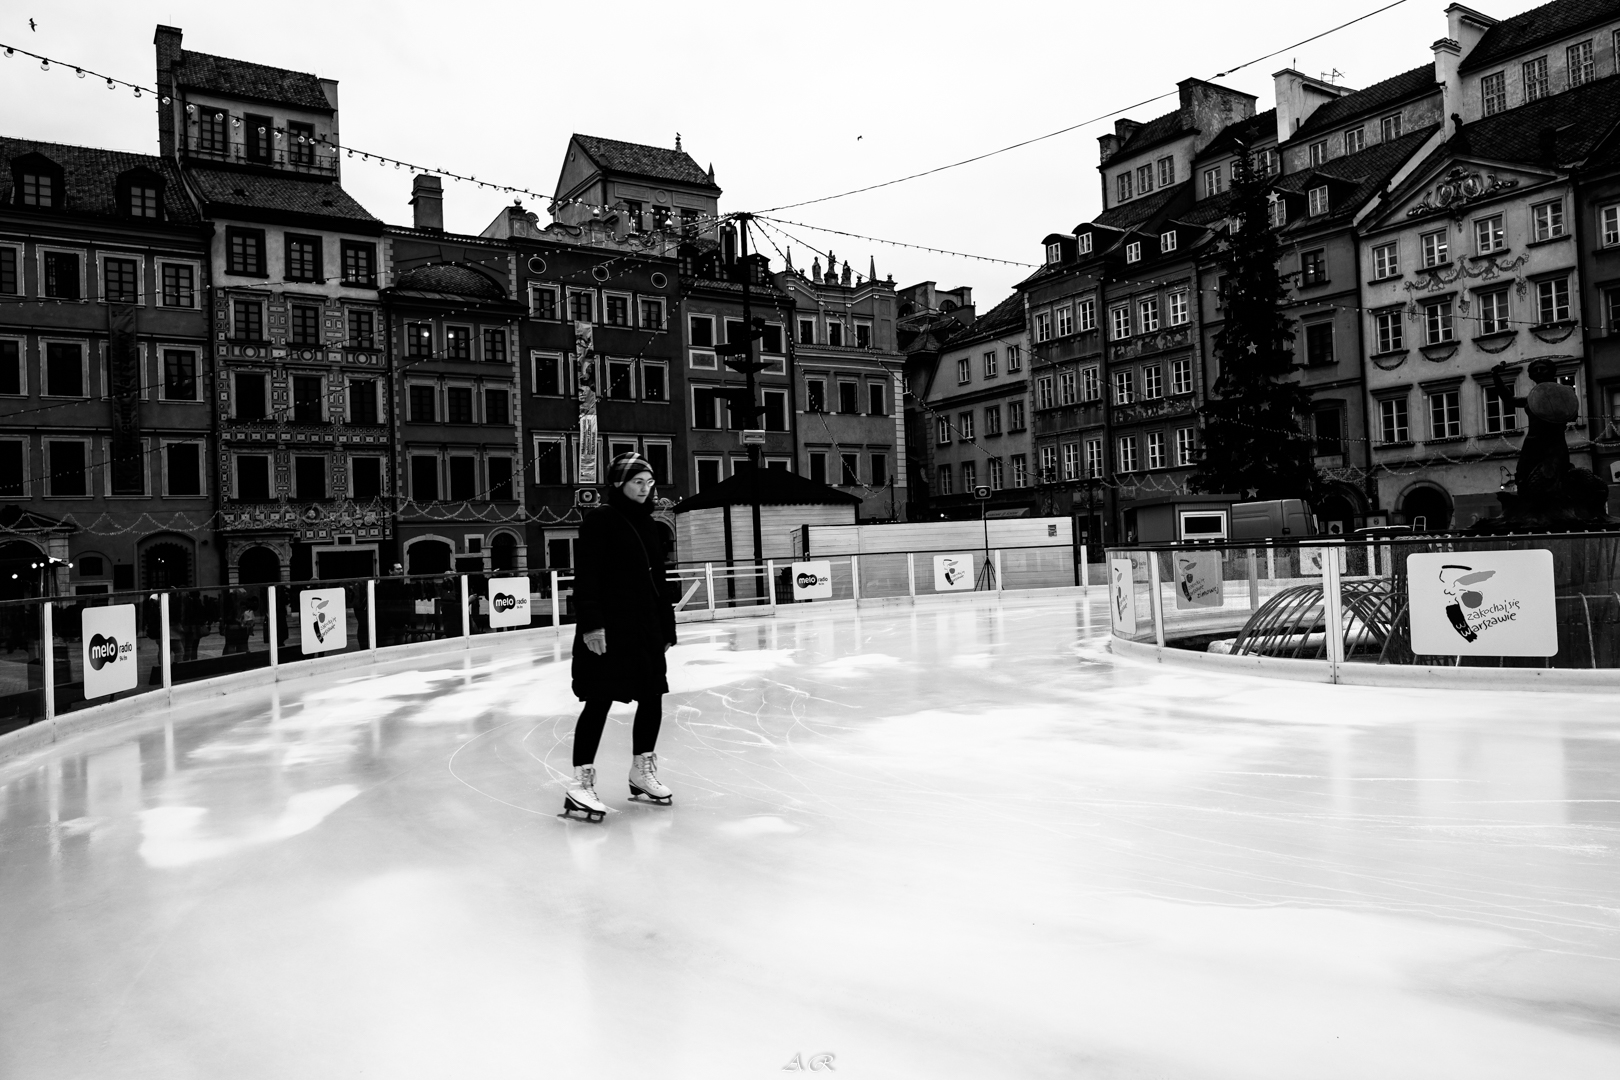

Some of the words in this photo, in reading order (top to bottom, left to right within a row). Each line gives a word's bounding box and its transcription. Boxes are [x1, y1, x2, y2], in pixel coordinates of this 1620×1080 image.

[495, 598, 514, 606] melo
[1467, 600, 1508, 620] zakochaj
[1508, 598, 1520, 610] się
[92, 642, 116, 659] melo
[119, 642, 132, 653] radio
